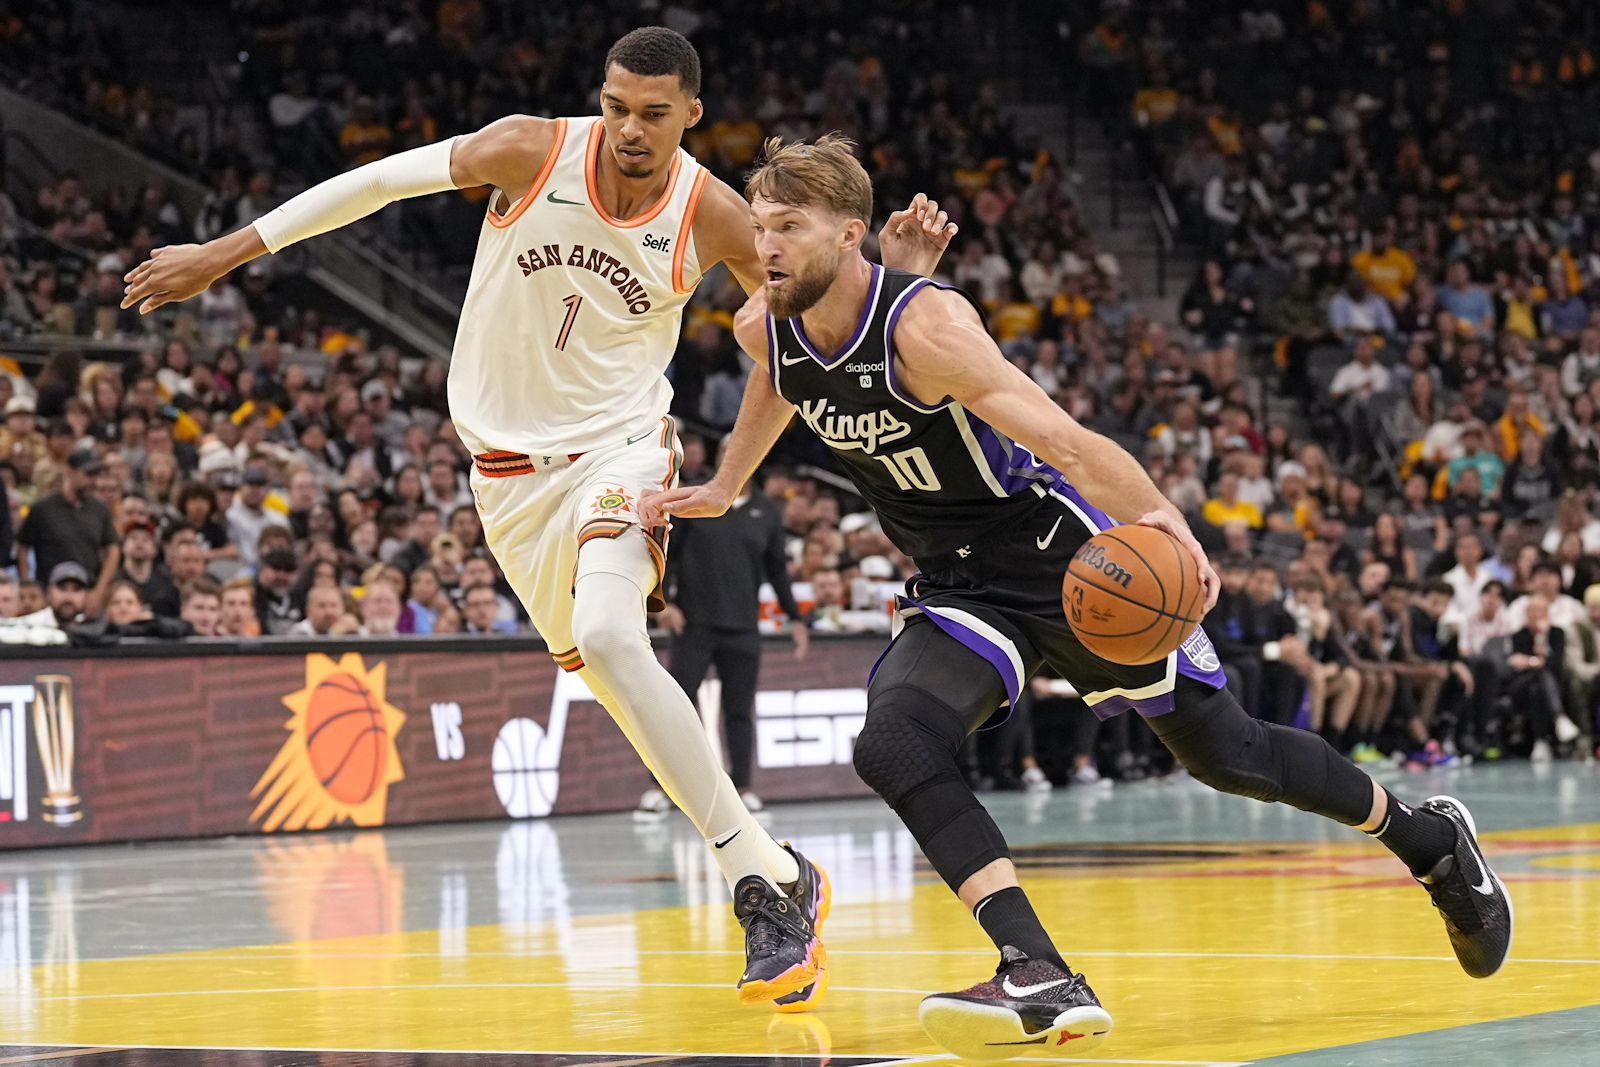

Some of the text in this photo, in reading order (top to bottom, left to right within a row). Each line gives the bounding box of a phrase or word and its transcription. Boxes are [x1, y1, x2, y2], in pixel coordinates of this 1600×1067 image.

[642, 233, 671, 253] Self.
[517, 244, 651, 315] SAN ANTONIO
[554, 294, 583, 352] 1
[845, 361, 885, 374] dialpad
[794, 398, 911, 454] Kings
[873, 446, 942, 491] 10
[430, 702, 466, 761] VS
[755, 688, 868, 768] ESP
